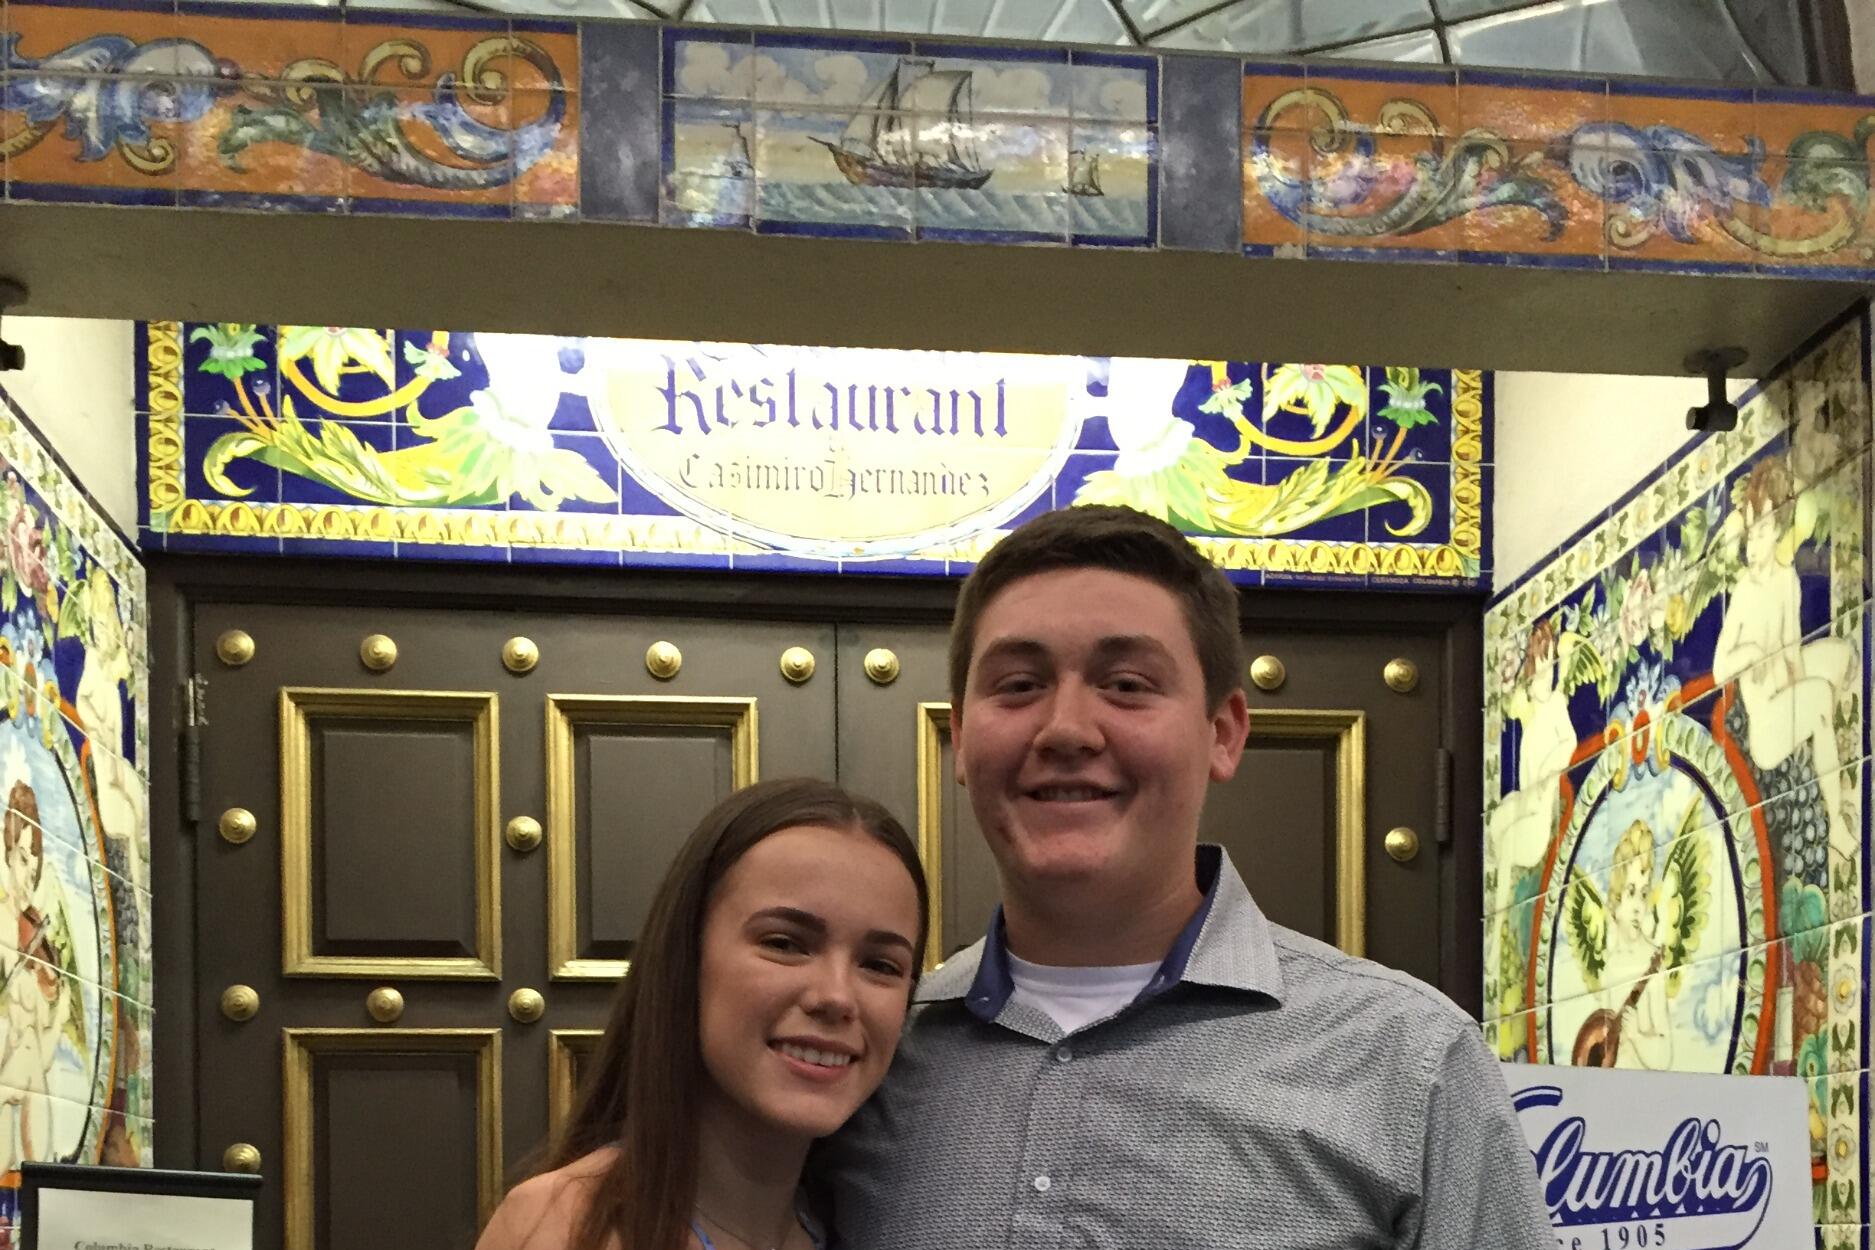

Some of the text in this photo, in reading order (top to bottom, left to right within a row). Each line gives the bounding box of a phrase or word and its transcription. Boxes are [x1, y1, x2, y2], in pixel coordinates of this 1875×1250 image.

[653, 354, 1009, 438] Restaurant
[679, 453, 824, 492] Casimiro
[1511, 1086, 1772, 1215] lumbia
[1601, 1223, 1666, 1250] 1905
